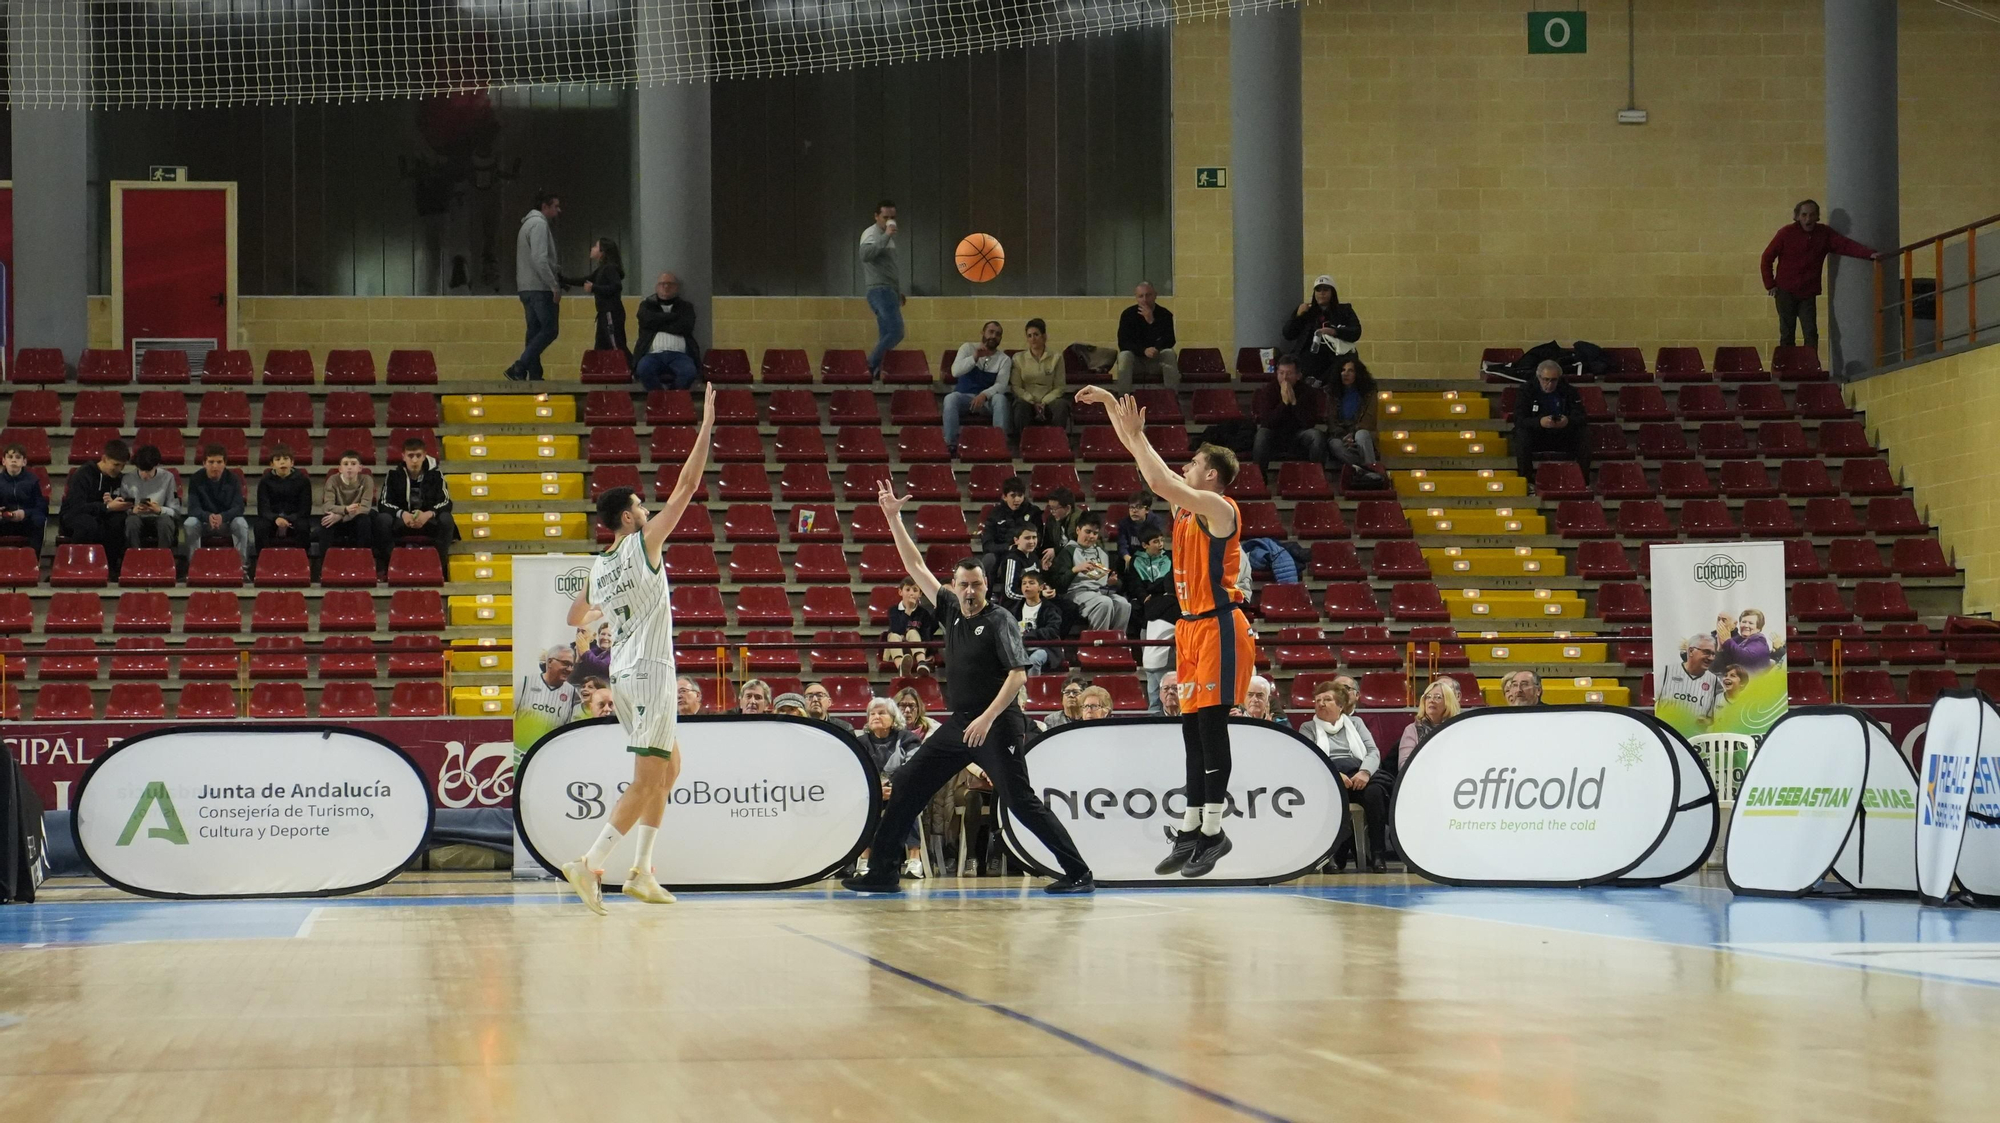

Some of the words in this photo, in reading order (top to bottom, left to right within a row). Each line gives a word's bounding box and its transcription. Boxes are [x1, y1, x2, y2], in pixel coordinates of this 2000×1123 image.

[596, 557, 633, 589] RODRIGZ
[557, 577, 584, 592] CORD
[1673, 692, 1699, 704] coto
[532, 703, 556, 714] coto
[198, 785, 254, 799] Junta
[261, 783, 285, 798] de
[291, 781, 390, 798] Andalucía
[1454, 767, 1605, 809] efficold
[1746, 787, 1776, 807] SAN
[1775, 786, 1853, 808] SEBASTIAN
[199, 804, 279, 821] Consejería
[285, 805, 303, 817] de
[308, 804, 373, 818] Turismo,
[731, 808, 778, 817] HOTELS
[200, 826, 253, 838] Cultura
[258, 828, 266, 840] y
[271, 825, 329, 839] Deporte
[1449, 819, 1496, 831] Partners
[1500, 819, 1544, 833] beyond
[1548, 819, 1567, 831] the
[1570, 819, 1596, 831] cold
